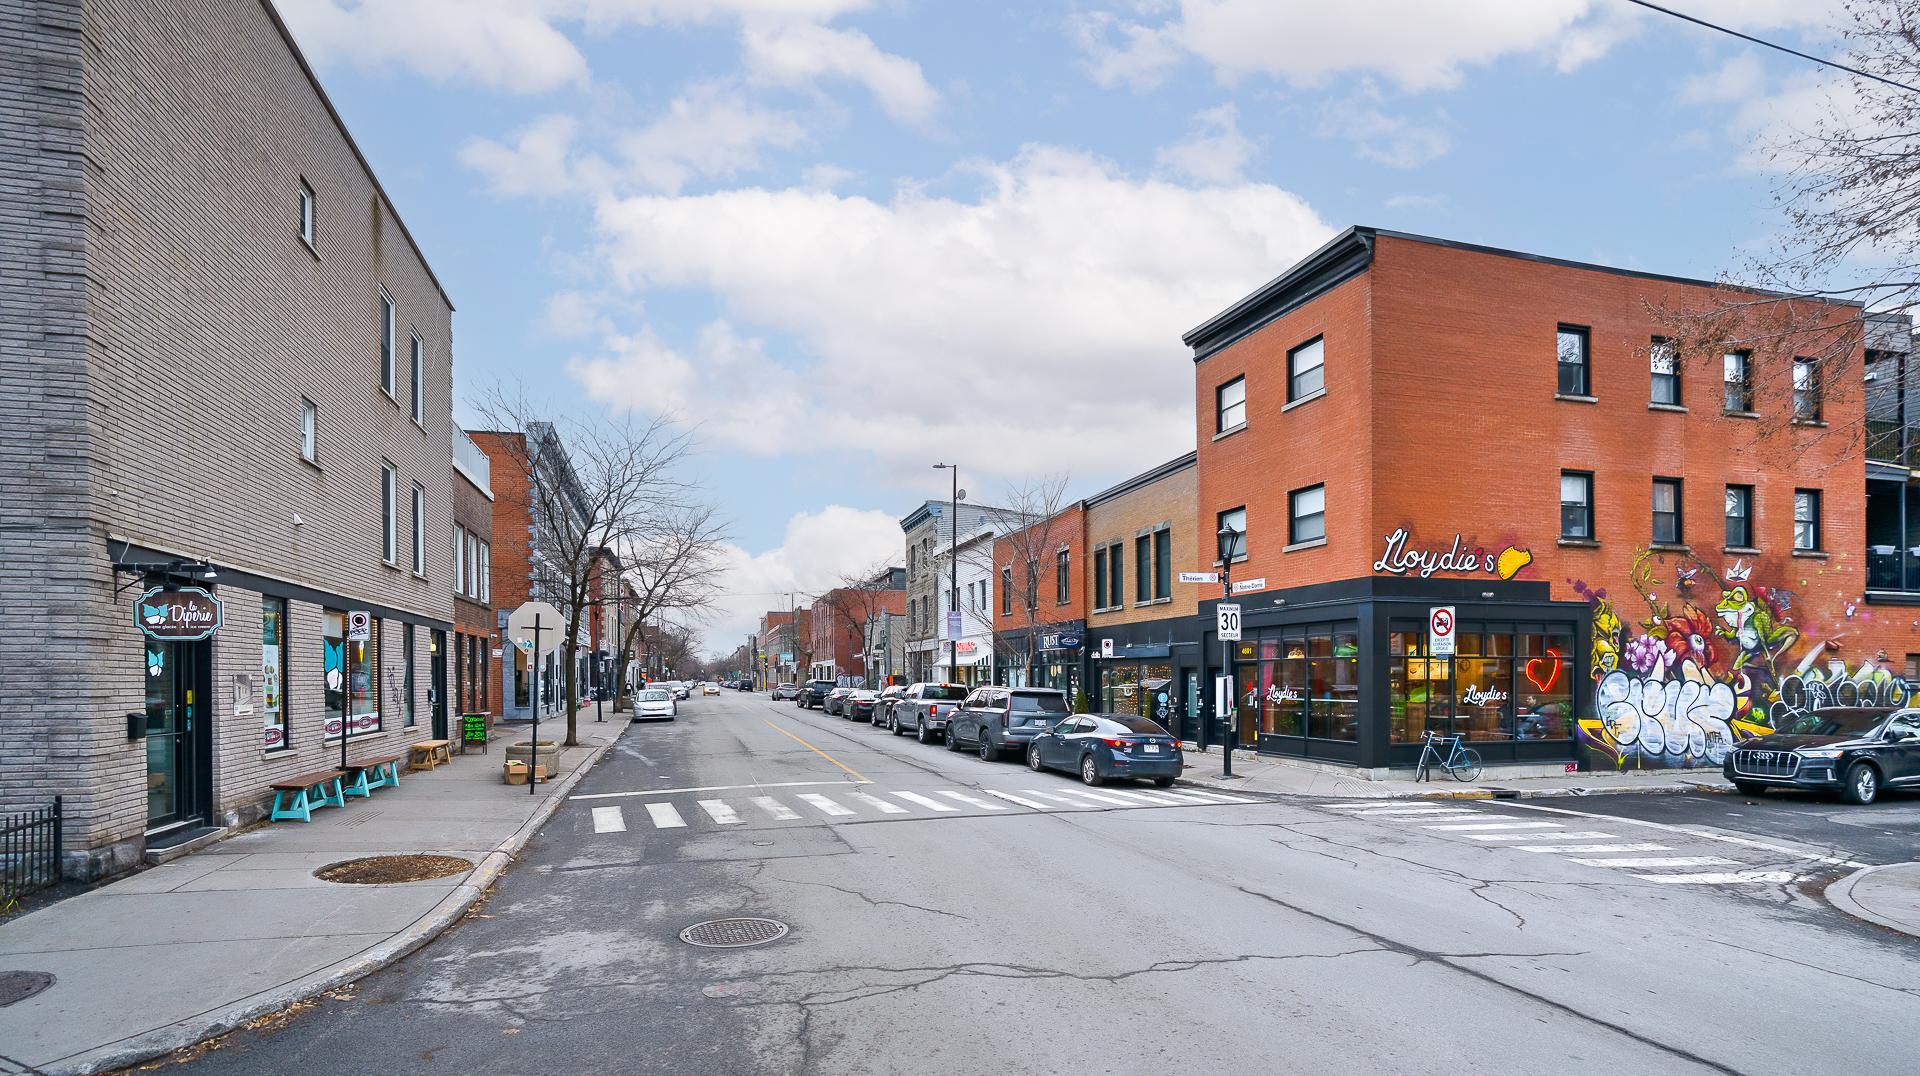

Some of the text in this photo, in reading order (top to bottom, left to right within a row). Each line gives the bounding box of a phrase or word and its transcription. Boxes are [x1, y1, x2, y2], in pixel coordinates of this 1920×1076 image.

[1373, 528, 1494, 578] Lloydie's
[168, 604, 213, 628] Diperie
[189, 600, 198, 611] la
[1221, 612, 1239, 631] 30
[1043, 634, 1059, 649] RUST
[1463, 684, 1507, 707] Lloydie's
